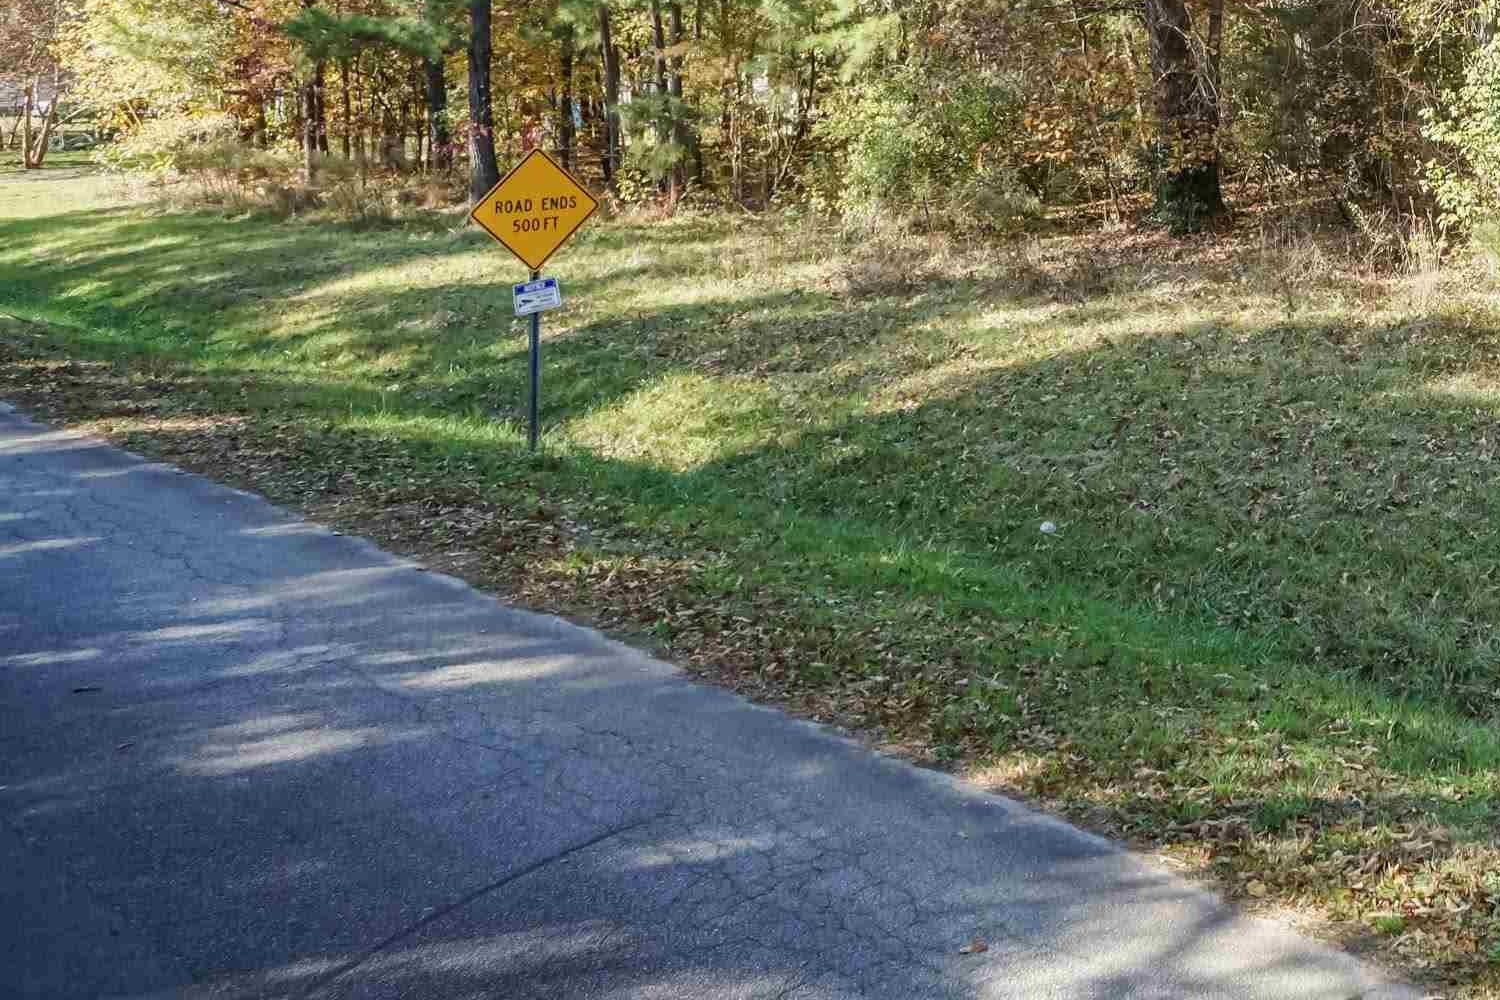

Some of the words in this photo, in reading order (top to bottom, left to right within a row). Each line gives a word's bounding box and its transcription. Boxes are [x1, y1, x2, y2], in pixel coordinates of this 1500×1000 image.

[495, 199, 533, 214] ROAD
[541, 196, 577, 211] ENDS
[513, 218, 540, 232] 500
[543, 216, 560, 231] FT
